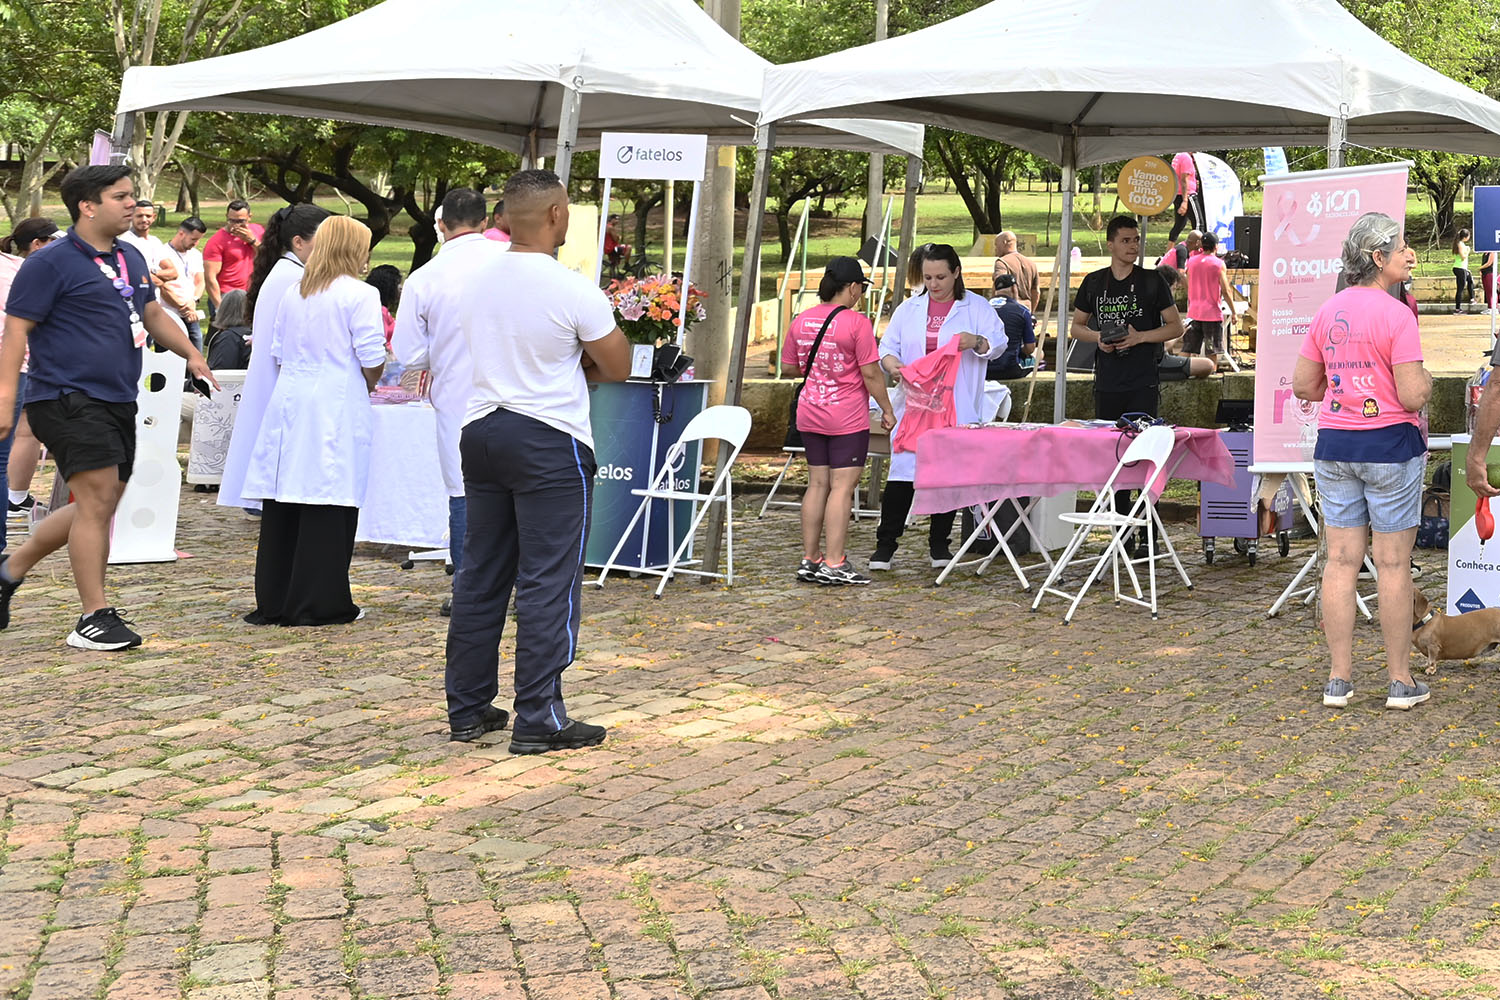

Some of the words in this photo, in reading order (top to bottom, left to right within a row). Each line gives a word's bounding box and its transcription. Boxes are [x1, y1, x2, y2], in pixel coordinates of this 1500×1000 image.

[635, 148, 683, 161] fatelos
[1128, 175, 1156, 188] fazer
[1134, 168, 1168, 182] Vamos
[1134, 186, 1157, 196] uma
[1129, 192, 1163, 207] foto?
[1273, 258, 1287, 278] O
[1290, 257, 1344, 279] toque
[1099, 303, 1137, 312] CRIATIVS
[1272, 309, 1293, 317] Nosso
[1277, 327, 1292, 337] pela
[1352, 375, 1376, 389] RCC
[594, 463, 633, 481] elos
[1455, 559, 1494, 573] Conheça
